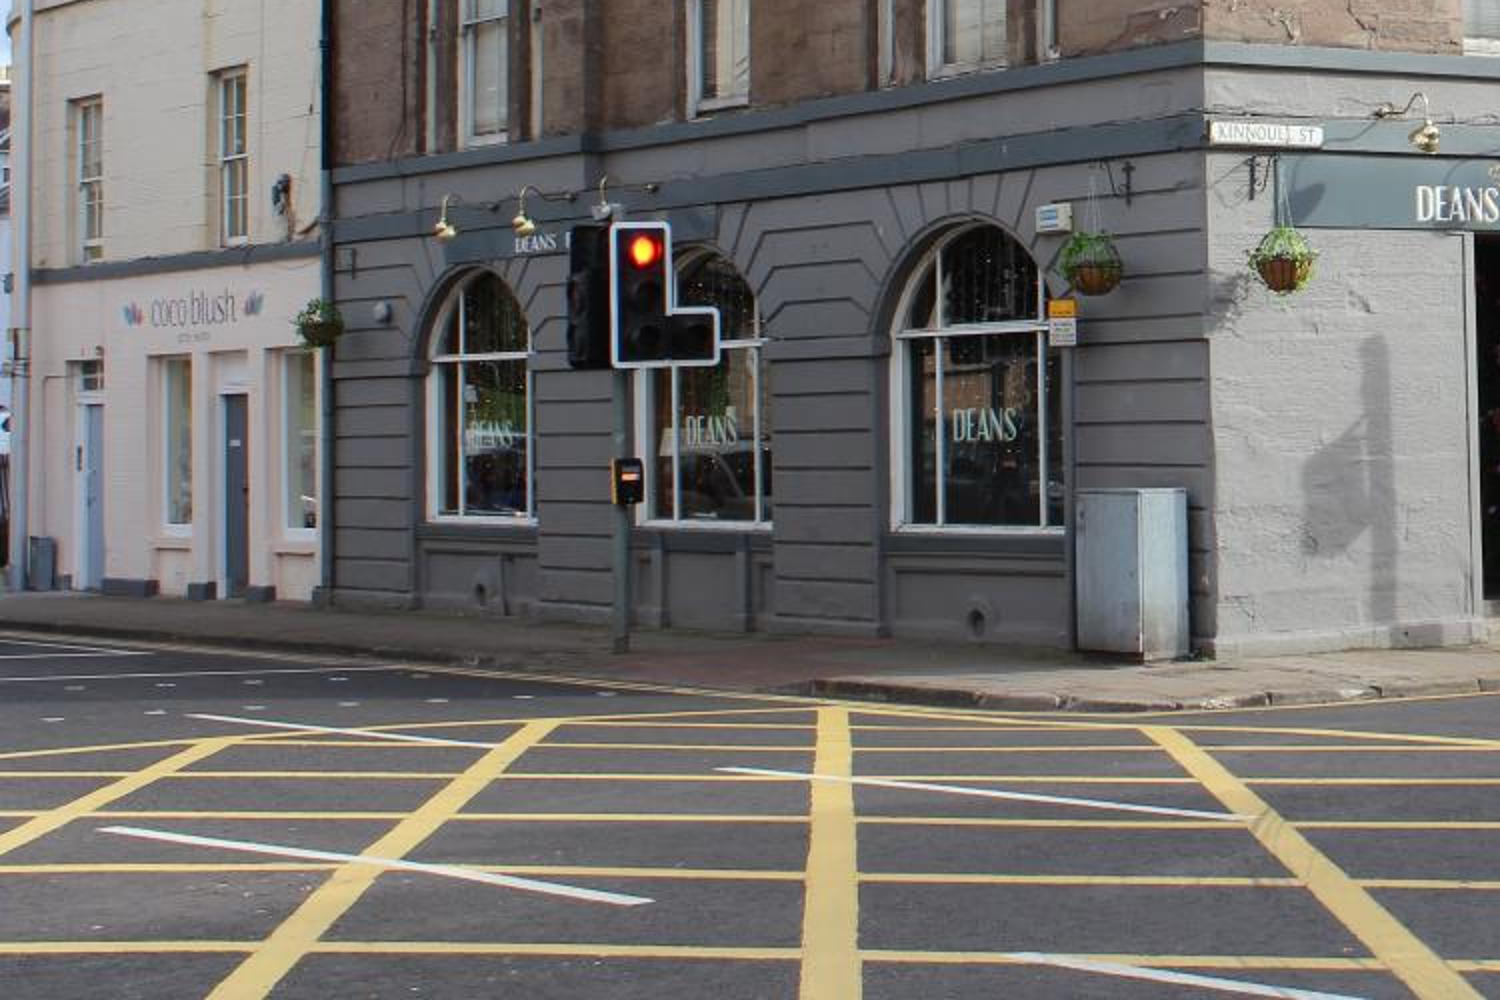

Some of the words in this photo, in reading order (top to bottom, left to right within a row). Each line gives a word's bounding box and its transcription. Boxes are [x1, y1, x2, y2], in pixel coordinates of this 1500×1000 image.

[1299, 129, 1315, 143] ST
[1416, 185, 1500, 223] DEANS
[152, 299, 187, 327] coco
[191, 288, 237, 326] blush
[687, 415, 737, 446] DEANS
[953, 407, 1017, 441] DEANS
